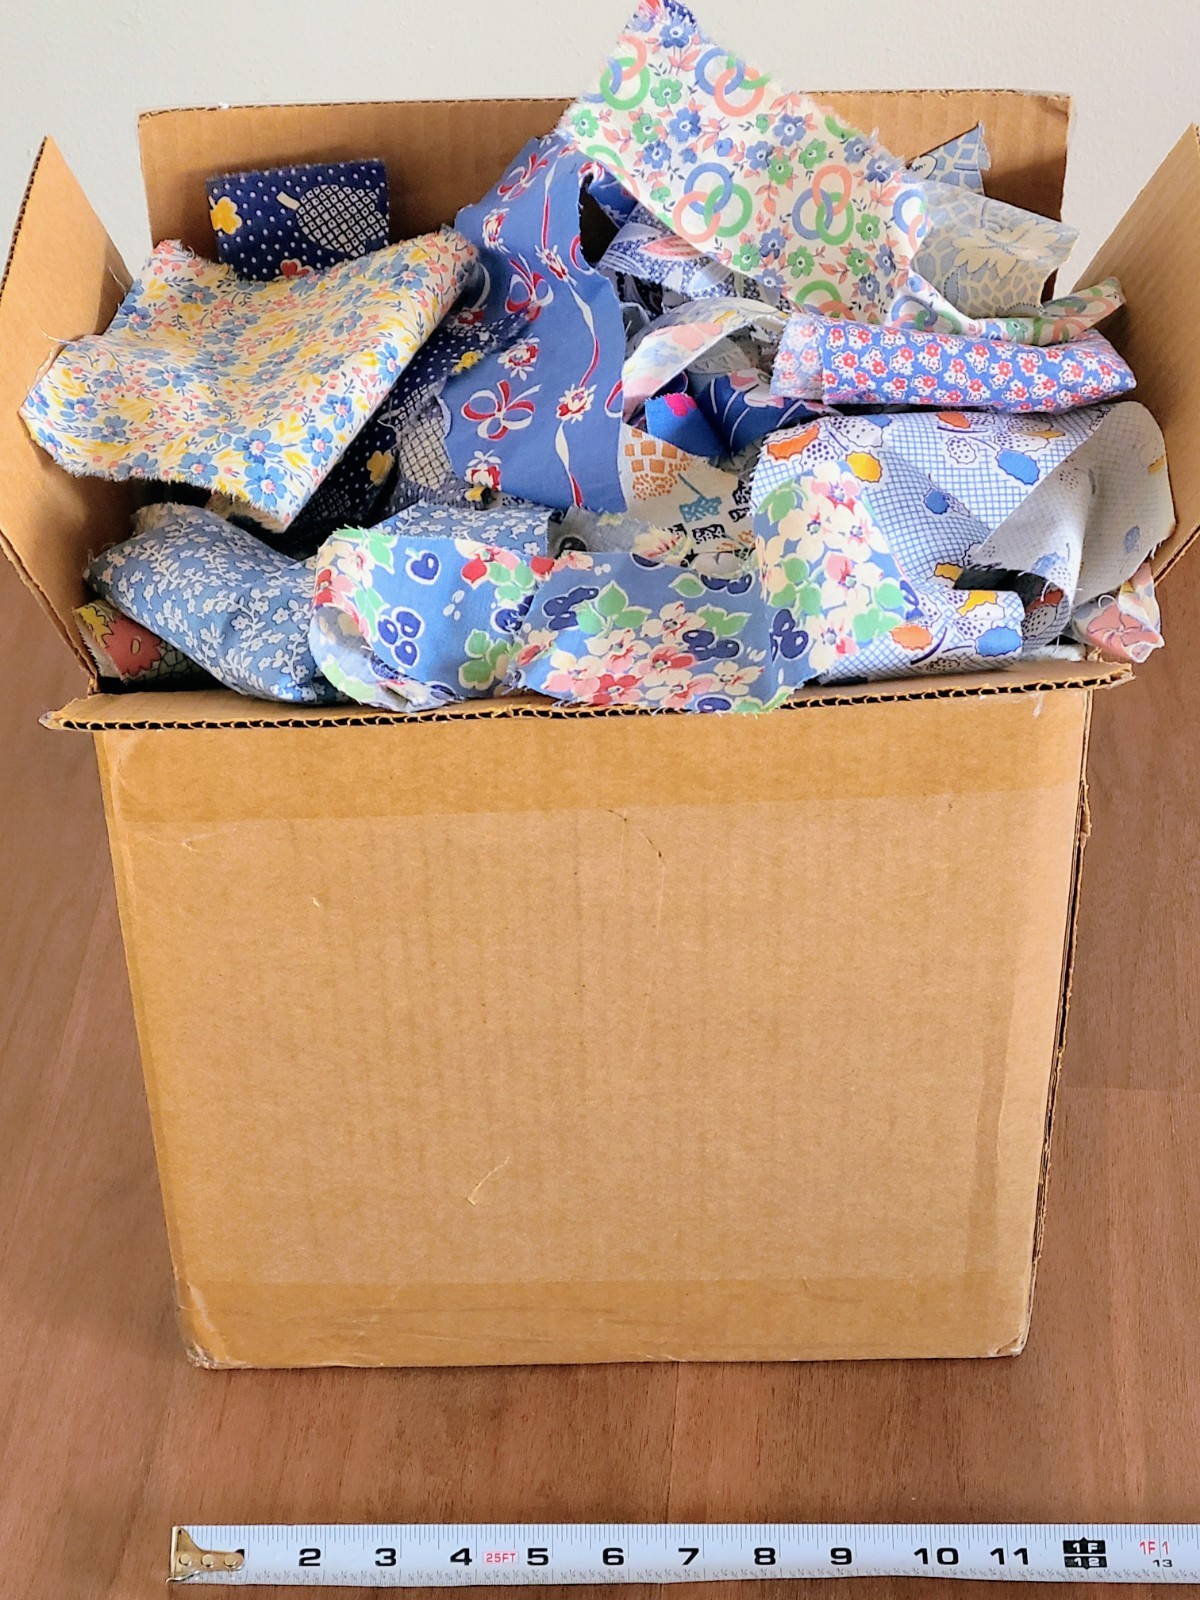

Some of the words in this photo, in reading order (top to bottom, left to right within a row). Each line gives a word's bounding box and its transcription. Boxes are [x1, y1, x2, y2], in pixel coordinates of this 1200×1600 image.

[1072, 1542, 1099, 1554] 1F
[298, 1547, 321, 1567] 2
[375, 1547, 397, 1567] 3
[450, 1547, 473, 1566] 4
[486, 1552, 516, 1563] 25FT
[527, 1547, 549, 1566] 5
[602, 1547, 625, 1566] 6
[678, 1547, 700, 1566] 7
[753, 1547, 776, 1566] 8
[830, 1547, 853, 1566] 9
[913, 1547, 959, 1565] 10
[990, 1547, 1029, 1565] 11
[1073, 1557, 1100, 1567] 12
[1152, 1559, 1173, 1568] 13
